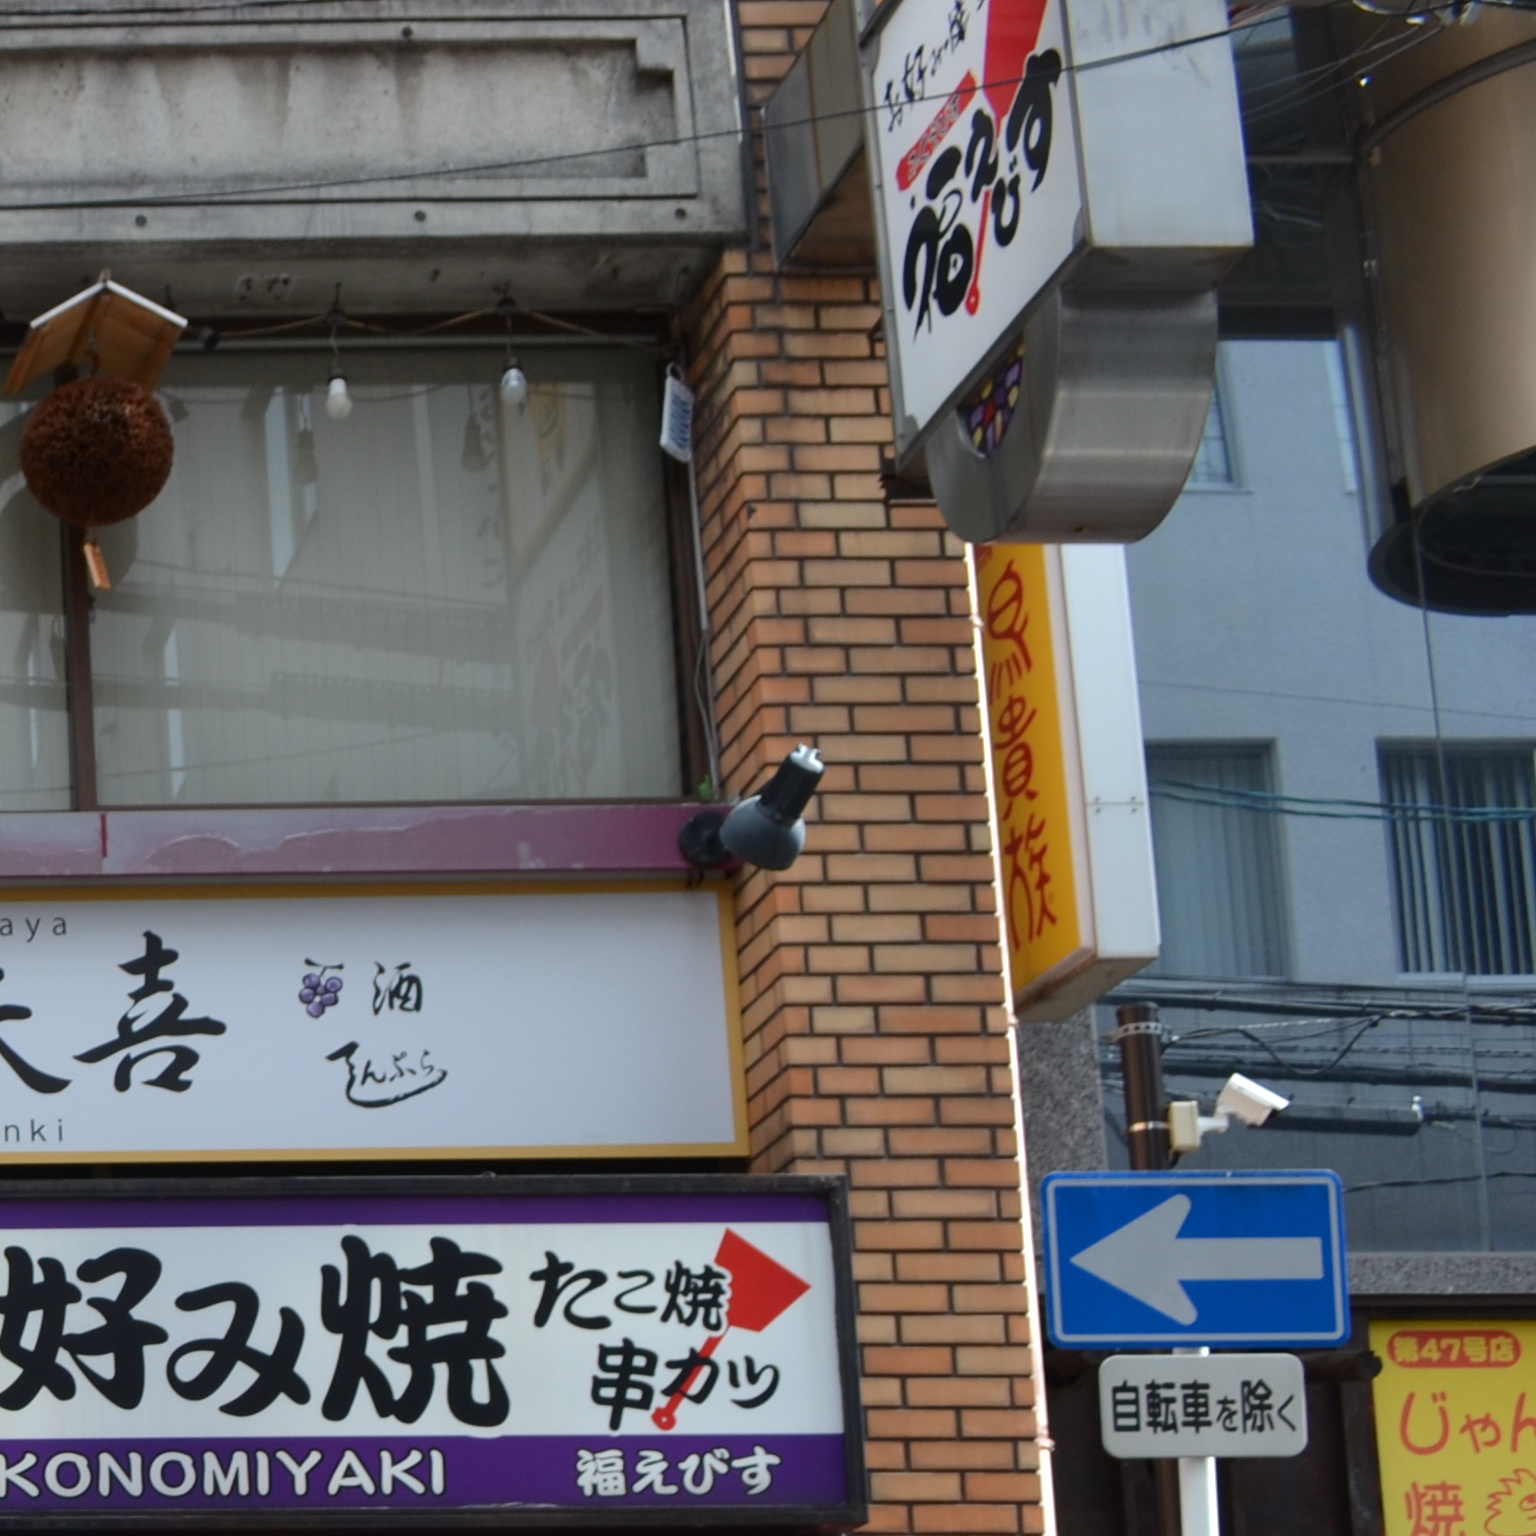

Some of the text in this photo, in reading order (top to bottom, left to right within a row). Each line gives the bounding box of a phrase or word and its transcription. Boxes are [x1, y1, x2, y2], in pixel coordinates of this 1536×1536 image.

[986, 558, 1058, 954] 鳥貴族
[371, 960, 425, 1016] 酒
[529, 1250, 730, 1332] たこ焼
[1392, 1334, 1516, 1364] 第47号店
[590, 1336, 782, 1432] 串カツ
[1110, 1379, 1297, 1437] 自転車を除く
[574, 1444, 783, 1498] 福えびす
